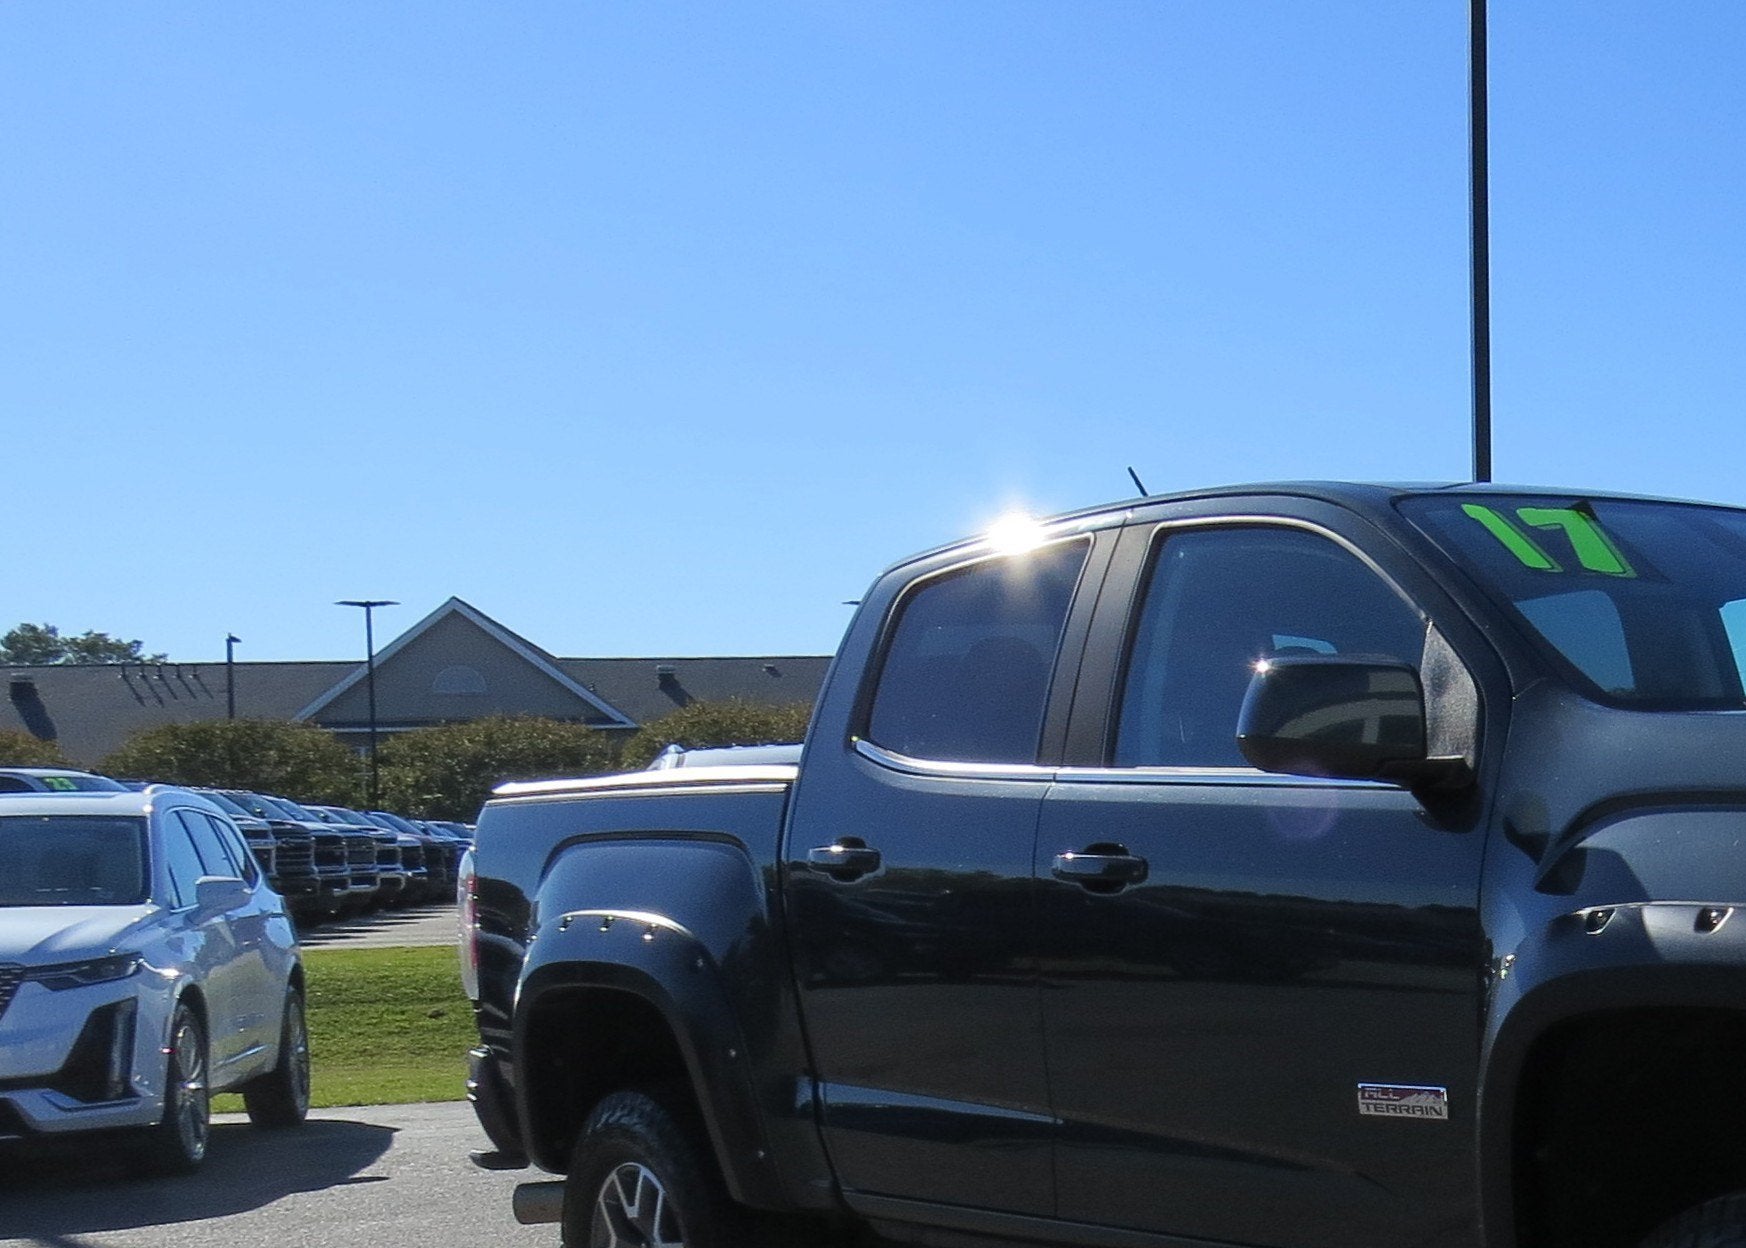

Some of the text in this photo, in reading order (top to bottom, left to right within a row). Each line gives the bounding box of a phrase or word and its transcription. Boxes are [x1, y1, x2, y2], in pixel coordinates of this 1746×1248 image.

[1461, 503, 1634, 577] 17
[1363, 1088, 1400, 1100] ALL
[1361, 1102, 1443, 1116] TERRAIN
